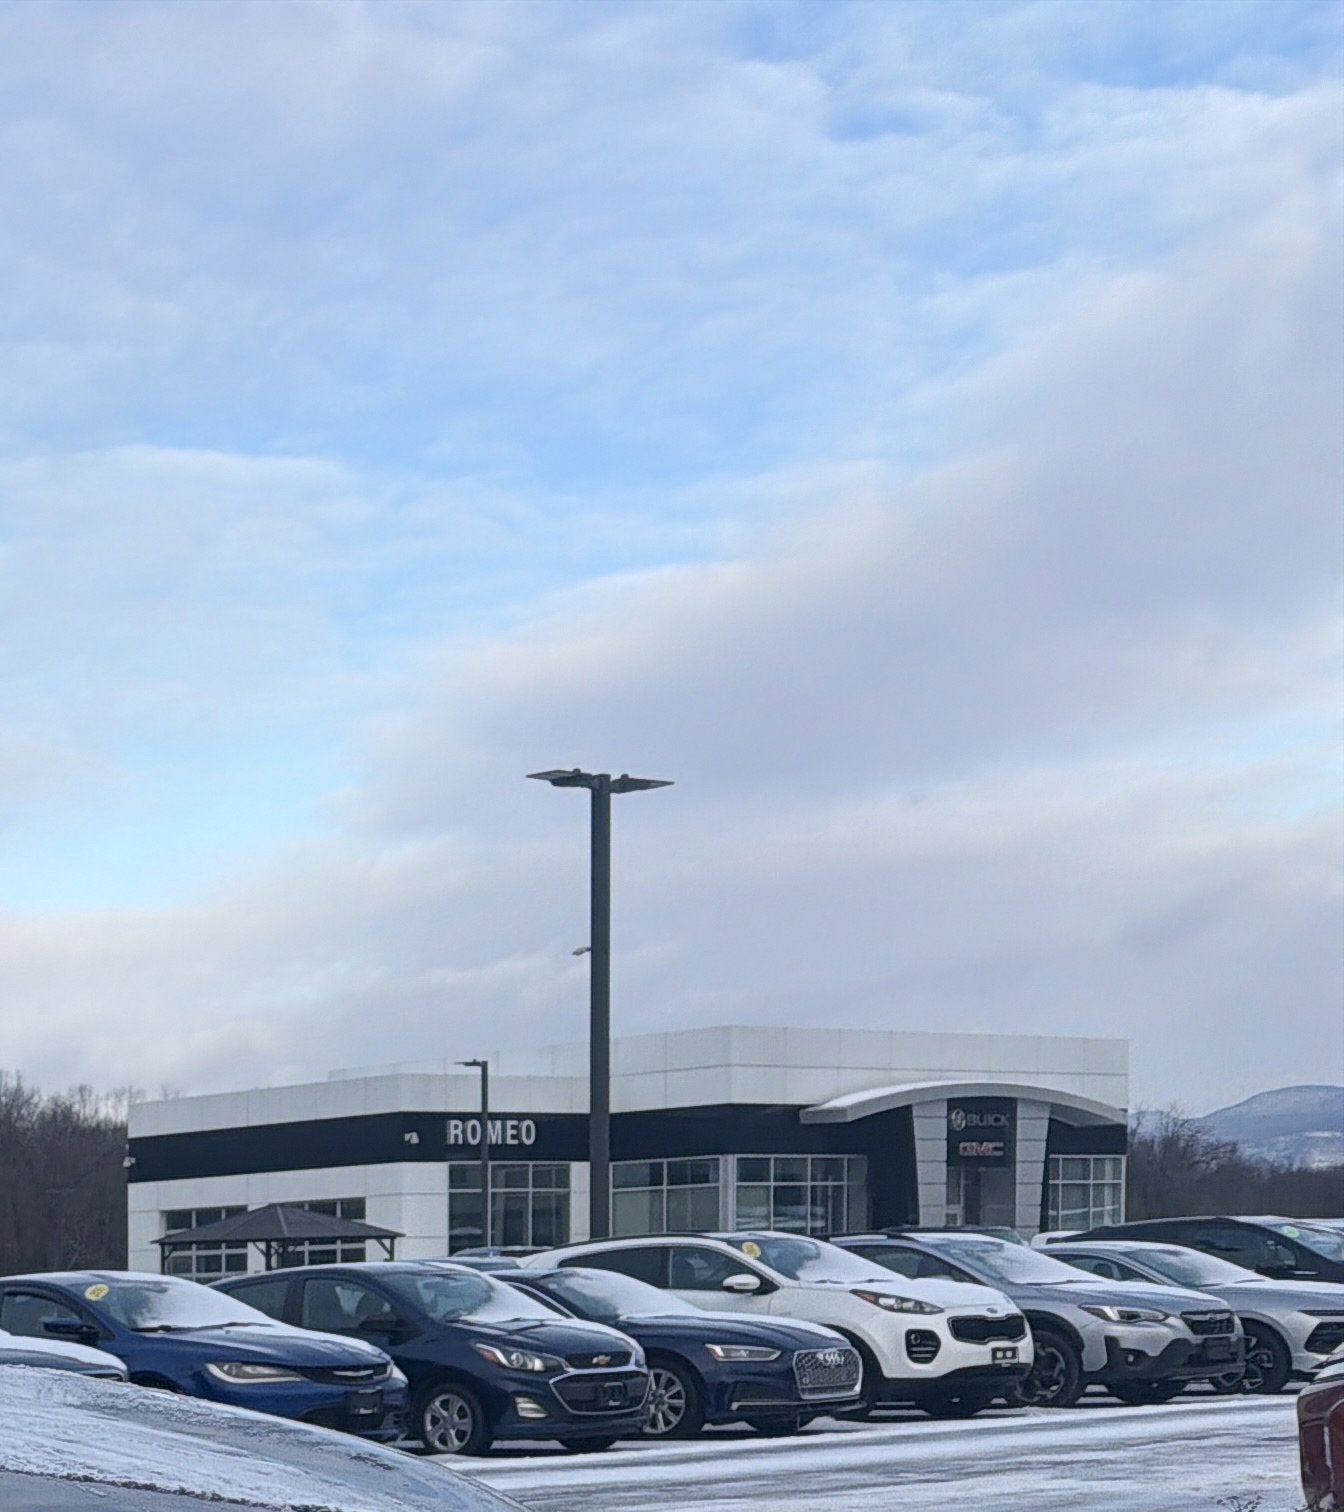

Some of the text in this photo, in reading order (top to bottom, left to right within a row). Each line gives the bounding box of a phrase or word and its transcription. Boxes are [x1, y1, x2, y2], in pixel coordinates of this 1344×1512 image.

[966, 1113, 1010, 1127] BUICK
[446, 1119, 536, 1146] ROMEO
[959, 1141, 1004, 1156] GMC
